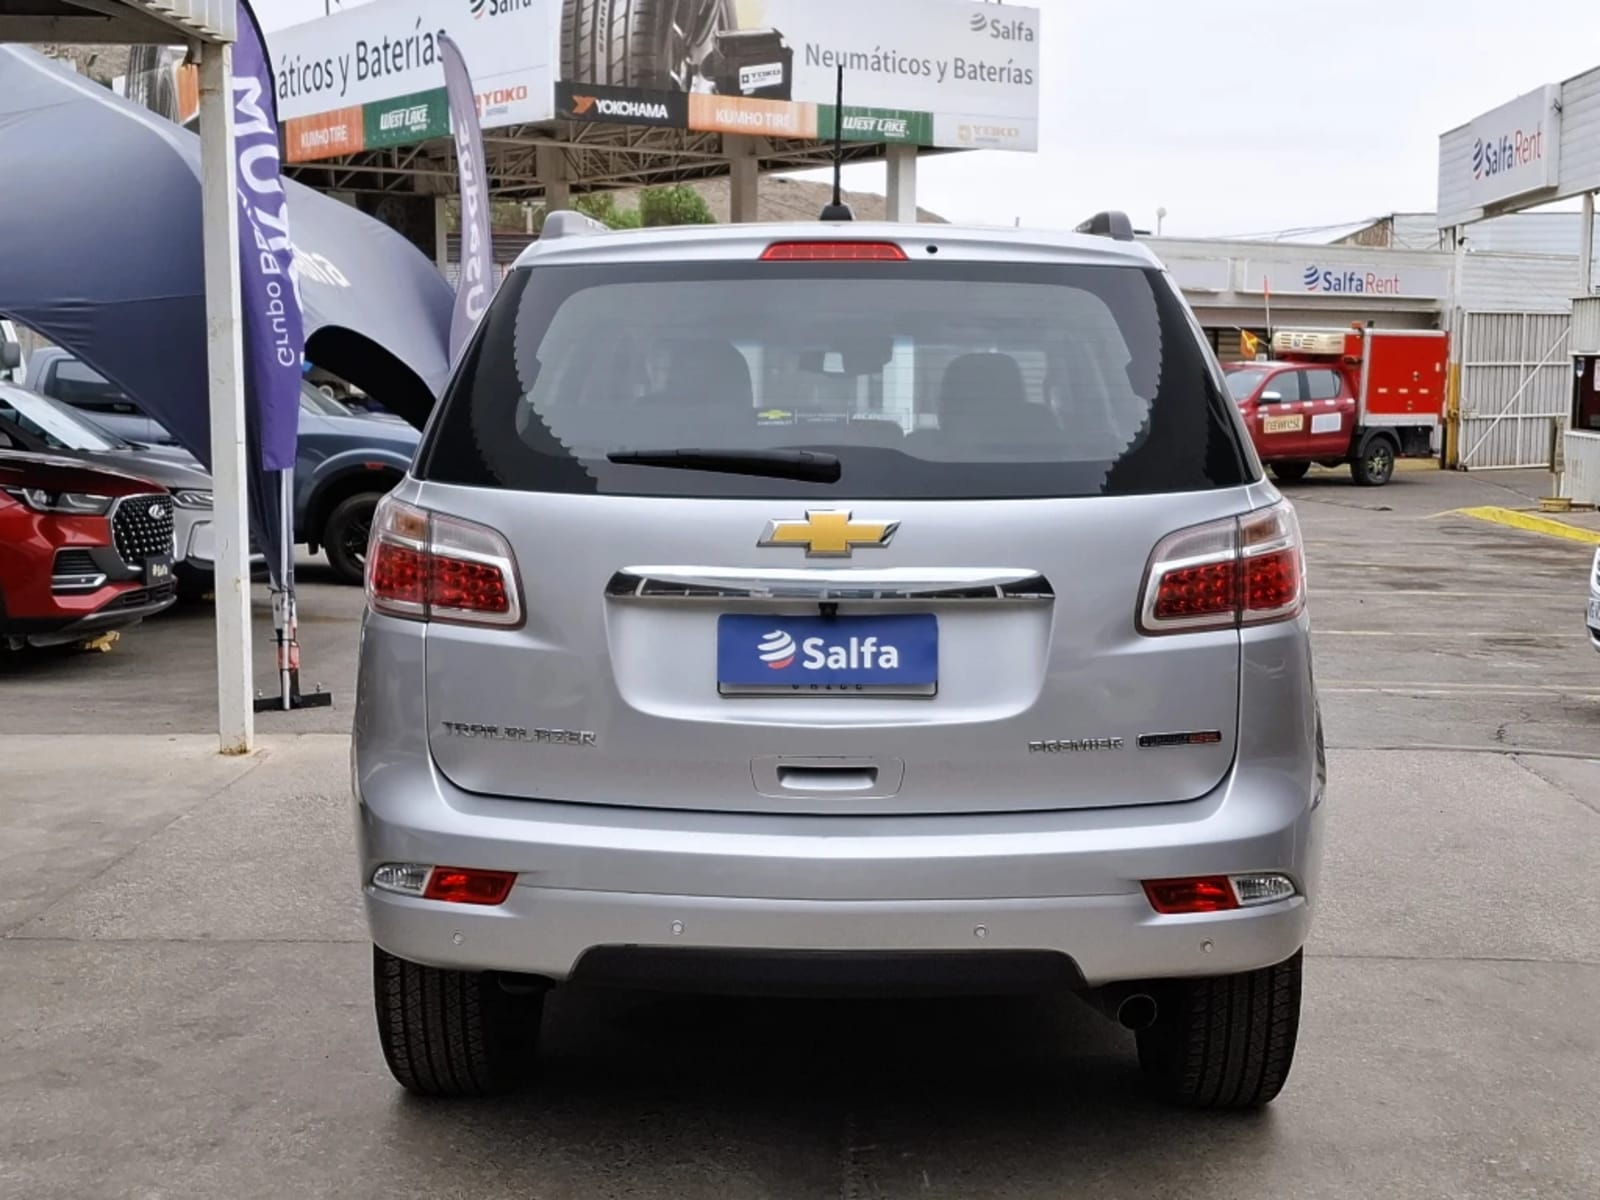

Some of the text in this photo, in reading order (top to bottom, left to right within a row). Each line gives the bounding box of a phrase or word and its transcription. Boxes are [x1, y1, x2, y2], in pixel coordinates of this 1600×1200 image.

[990, 18, 1034, 42] Salfa
[278, 54, 334, 100] áticos
[338, 53, 350, 97] y
[805, 42, 1033, 85] Neumáticos y Baterías
[483, 85, 528, 106] YOKO
[595, 99, 669, 119] YOKOHAMA
[1485, 122, 1541, 177] SalfaRent
[1322, 271, 1400, 295] SalfaRent
[802, 636, 900, 670] Salfa
